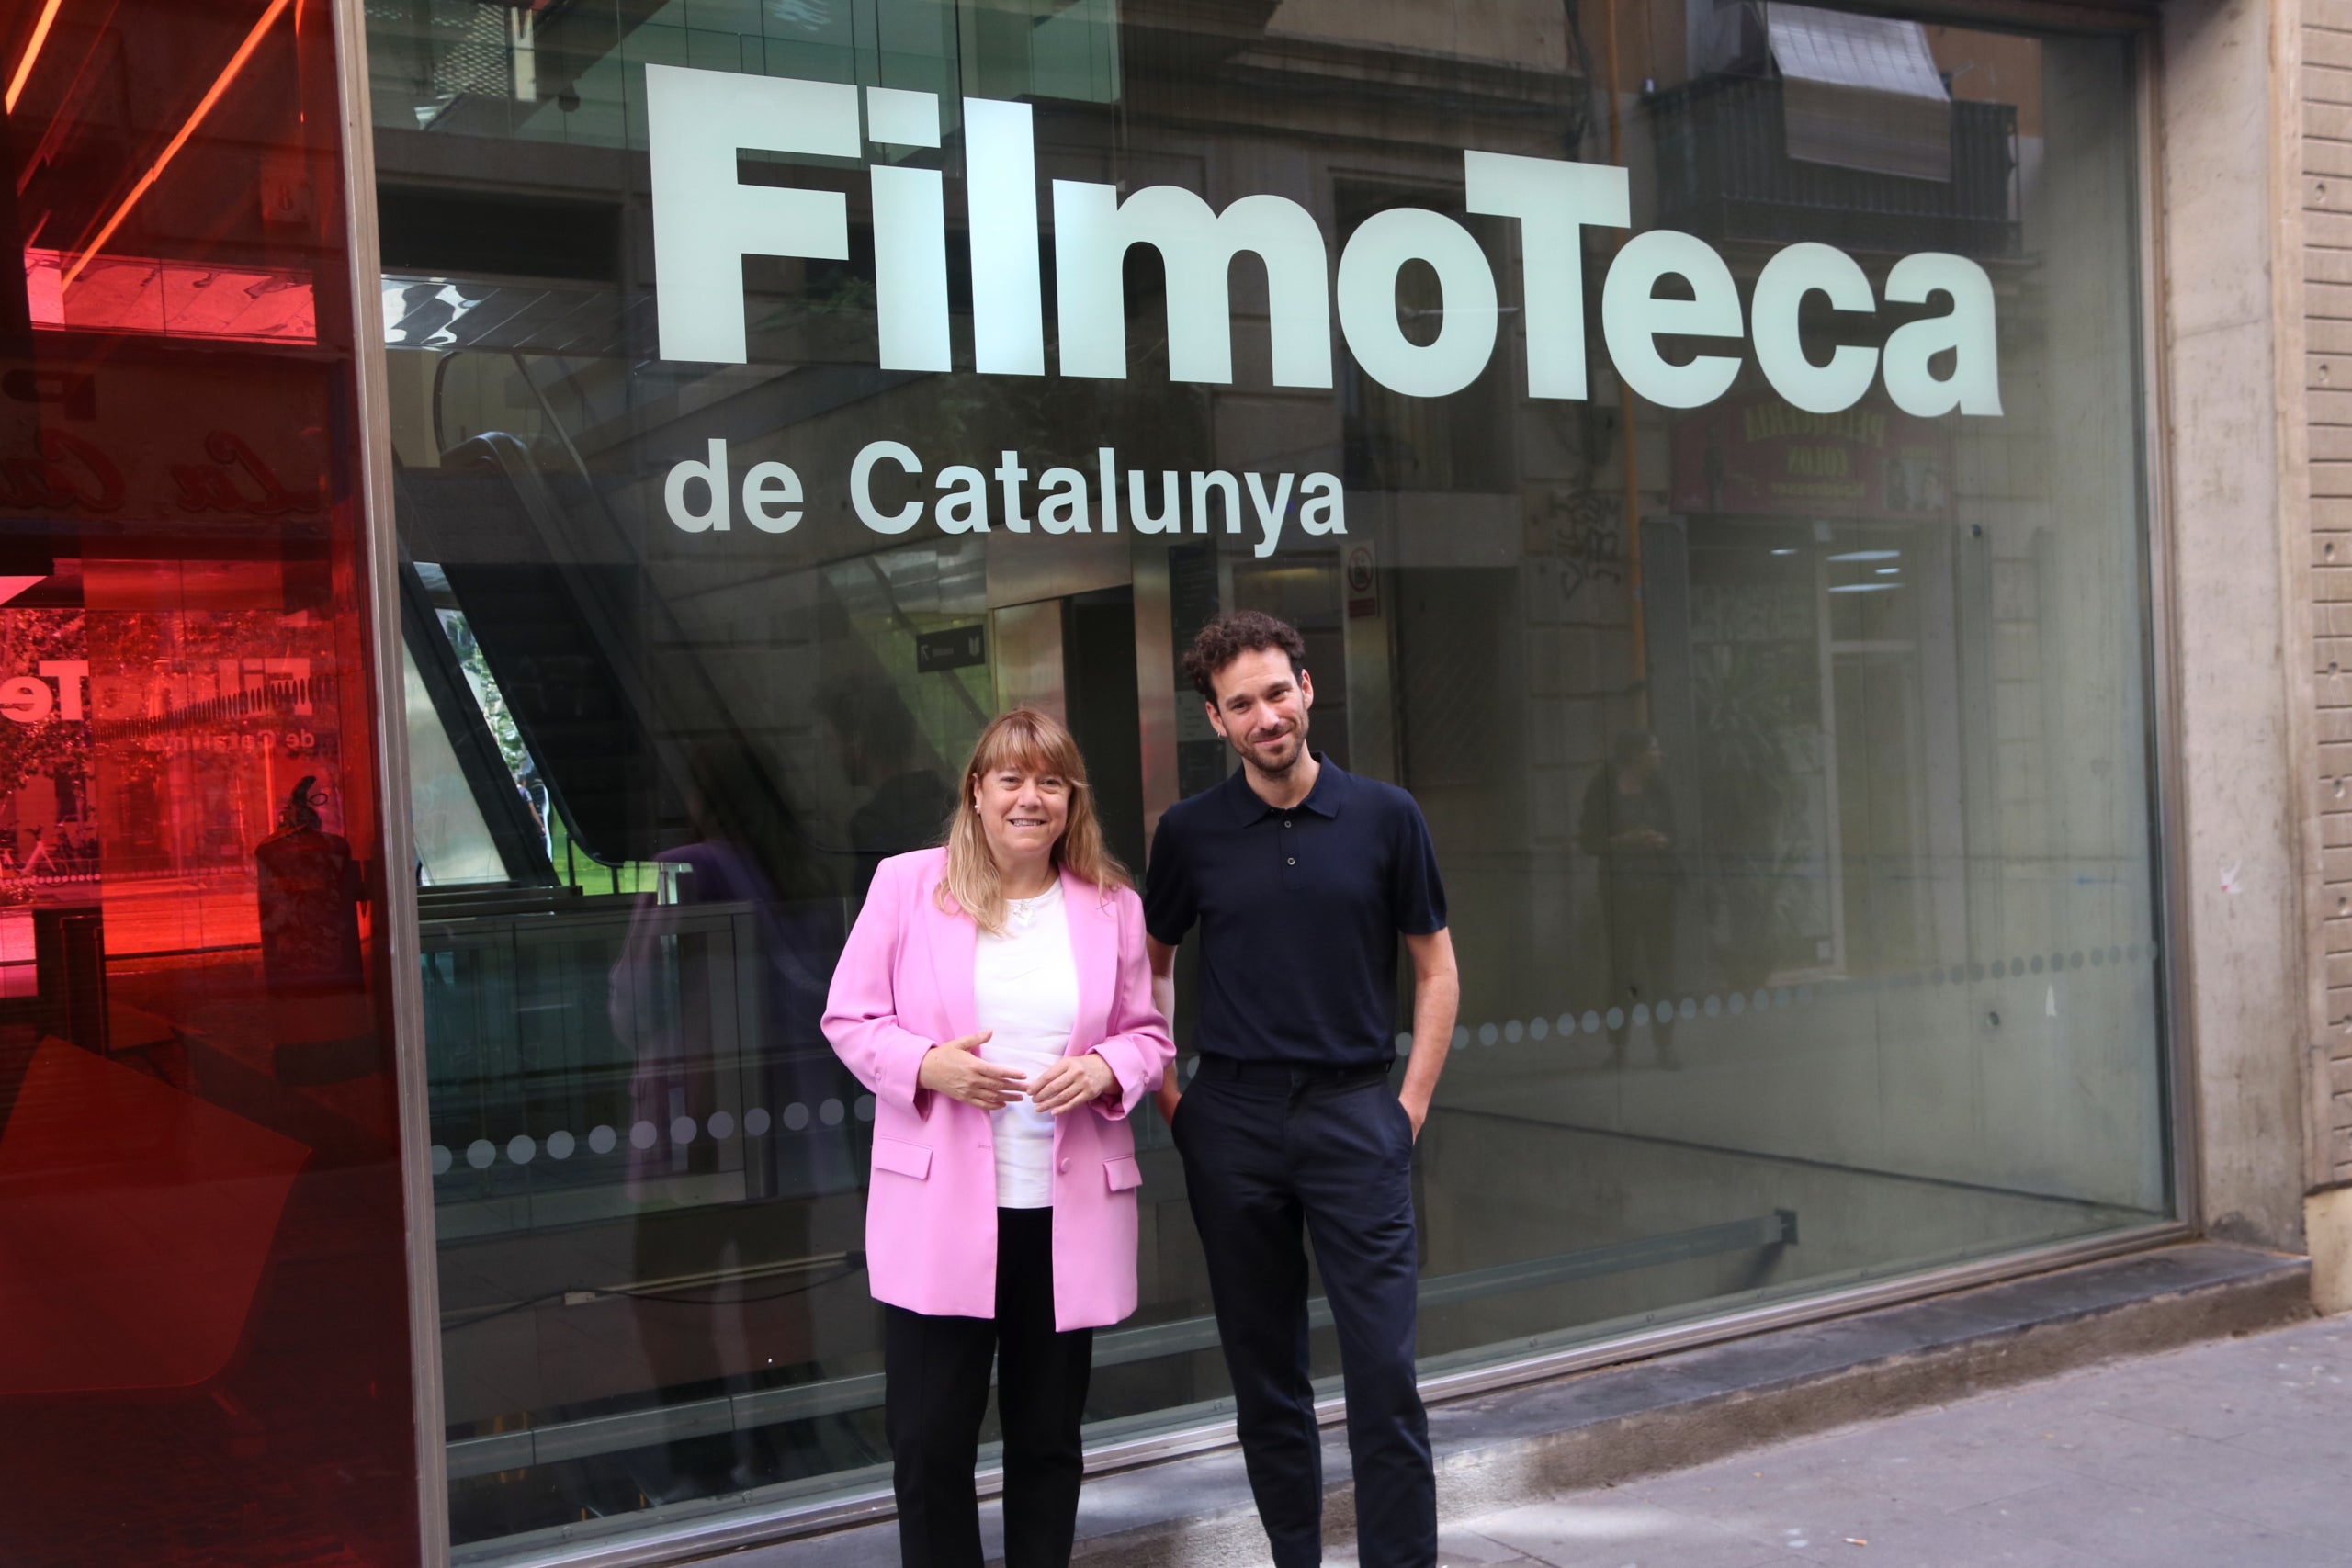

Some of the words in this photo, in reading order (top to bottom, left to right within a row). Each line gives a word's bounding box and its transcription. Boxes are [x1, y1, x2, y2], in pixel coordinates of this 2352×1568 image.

[646, 63, 2003, 417] FilmoTeca
[665, 439, 803, 533] de
[851, 441, 1347, 557] Catalunya
